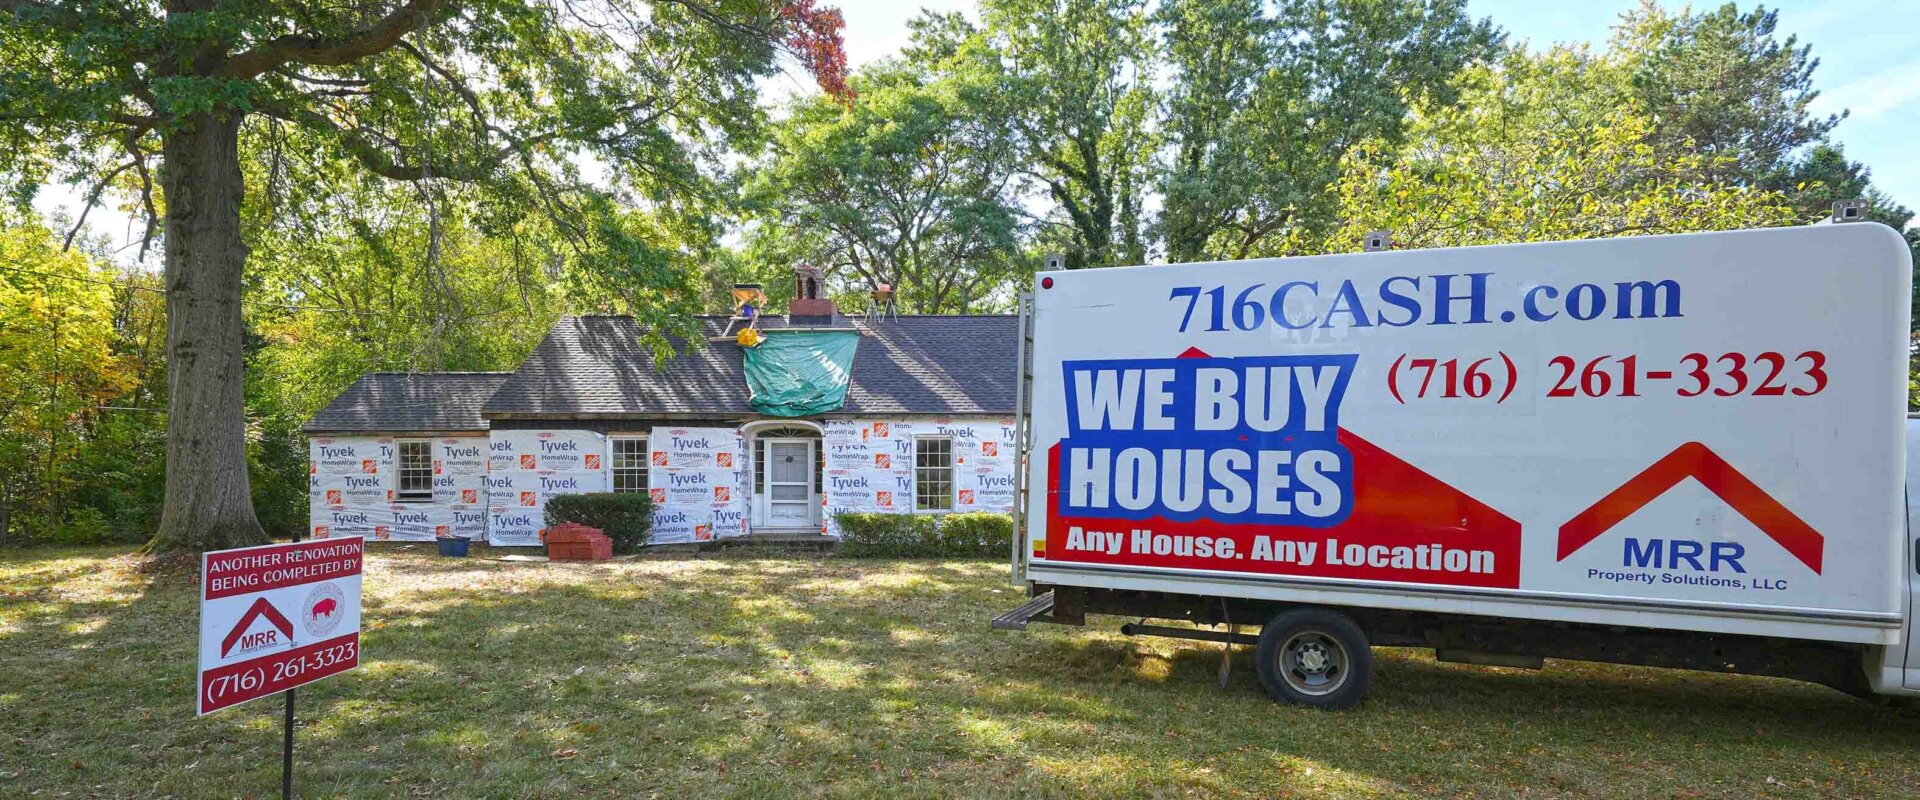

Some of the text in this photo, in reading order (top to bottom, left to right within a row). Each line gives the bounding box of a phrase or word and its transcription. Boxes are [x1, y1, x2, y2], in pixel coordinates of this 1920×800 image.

[1169, 272, 1684, 332] 716CASH.com
[1388, 350, 1828, 404] (716) 261-3323
[1074, 365, 1341, 432] WE BUY
[490, 440, 512, 451] vek
[540, 440, 576, 453] Tyvek
[672, 437, 709, 451] Tyvek
[320, 446, 355, 457] Tyvek
[445, 446, 479, 457] Tyvek
[344, 476, 379, 487] Tyvek
[433, 476, 454, 486] vek
[489, 477, 512, 488] vek
[540, 477, 577, 490] Tyvek
[669, 473, 706, 487] Tyvek
[831, 476, 868, 490] Tyvek
[1069, 446, 1341, 517] HOUSES
[332, 512, 367, 524] Tyvek
[392, 512, 428, 524] Tyvek
[493, 515, 530, 528] Tyvek
[713, 510, 742, 523] Tyve
[1065, 526, 1495, 574] Any House. Any Location
[1623, 537, 1747, 574] MRR
[209, 543, 361, 574] ANOTHER RENOVATION
[212, 558, 359, 591] BEING COMPLETED BY
[1587, 568, 1788, 590] Property Solutions, LLC
[241, 630, 277, 649] MRR
[207, 642, 355, 704] (716) 261-3323
